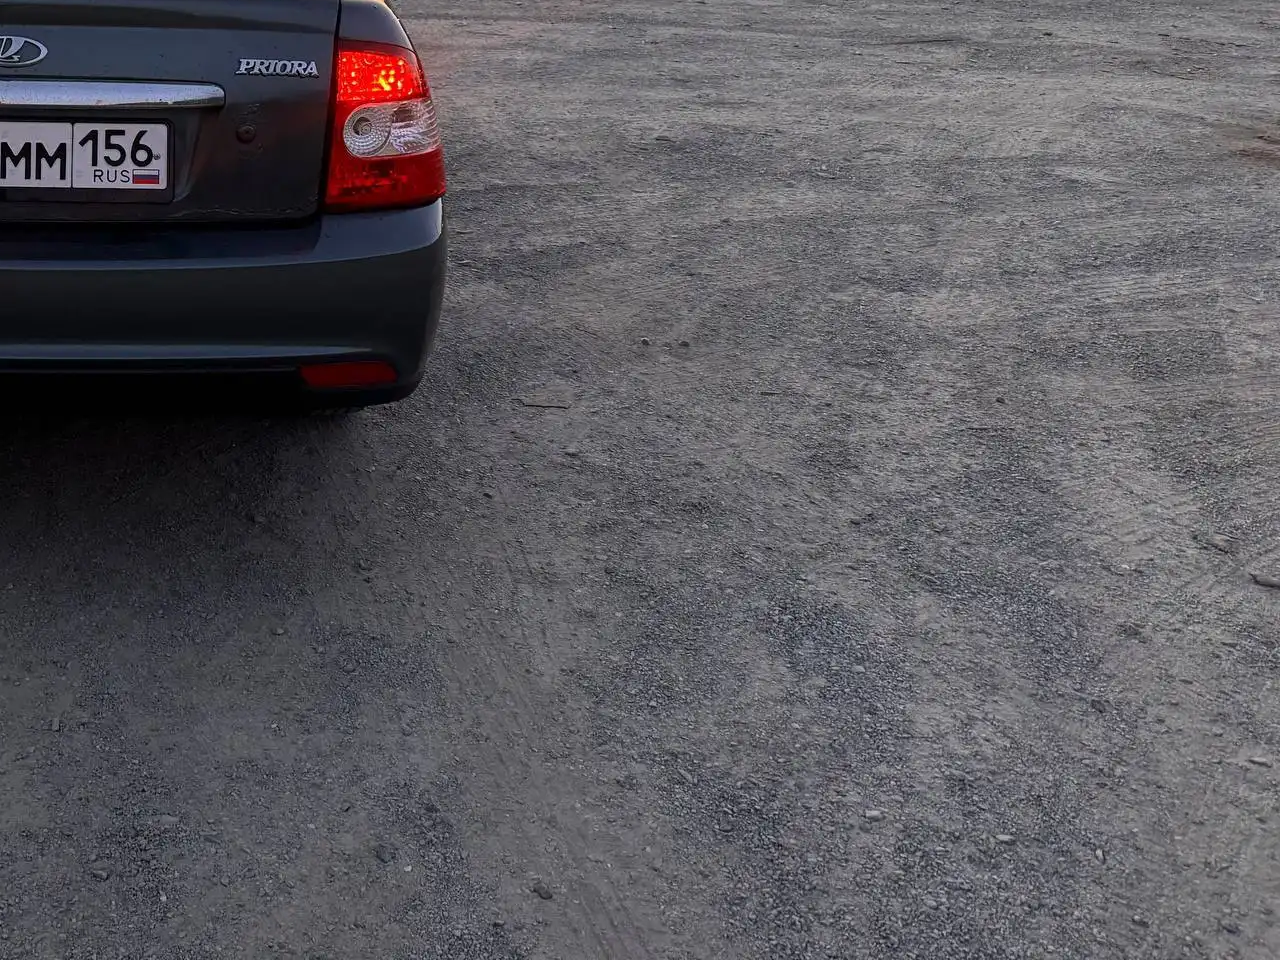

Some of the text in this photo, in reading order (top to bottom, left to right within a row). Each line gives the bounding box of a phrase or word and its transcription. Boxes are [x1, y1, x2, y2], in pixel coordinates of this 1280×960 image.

[235, 58, 319, 77] PRIORA
[78, 129, 153, 167] 156
[93, 169, 130, 183] RUS
